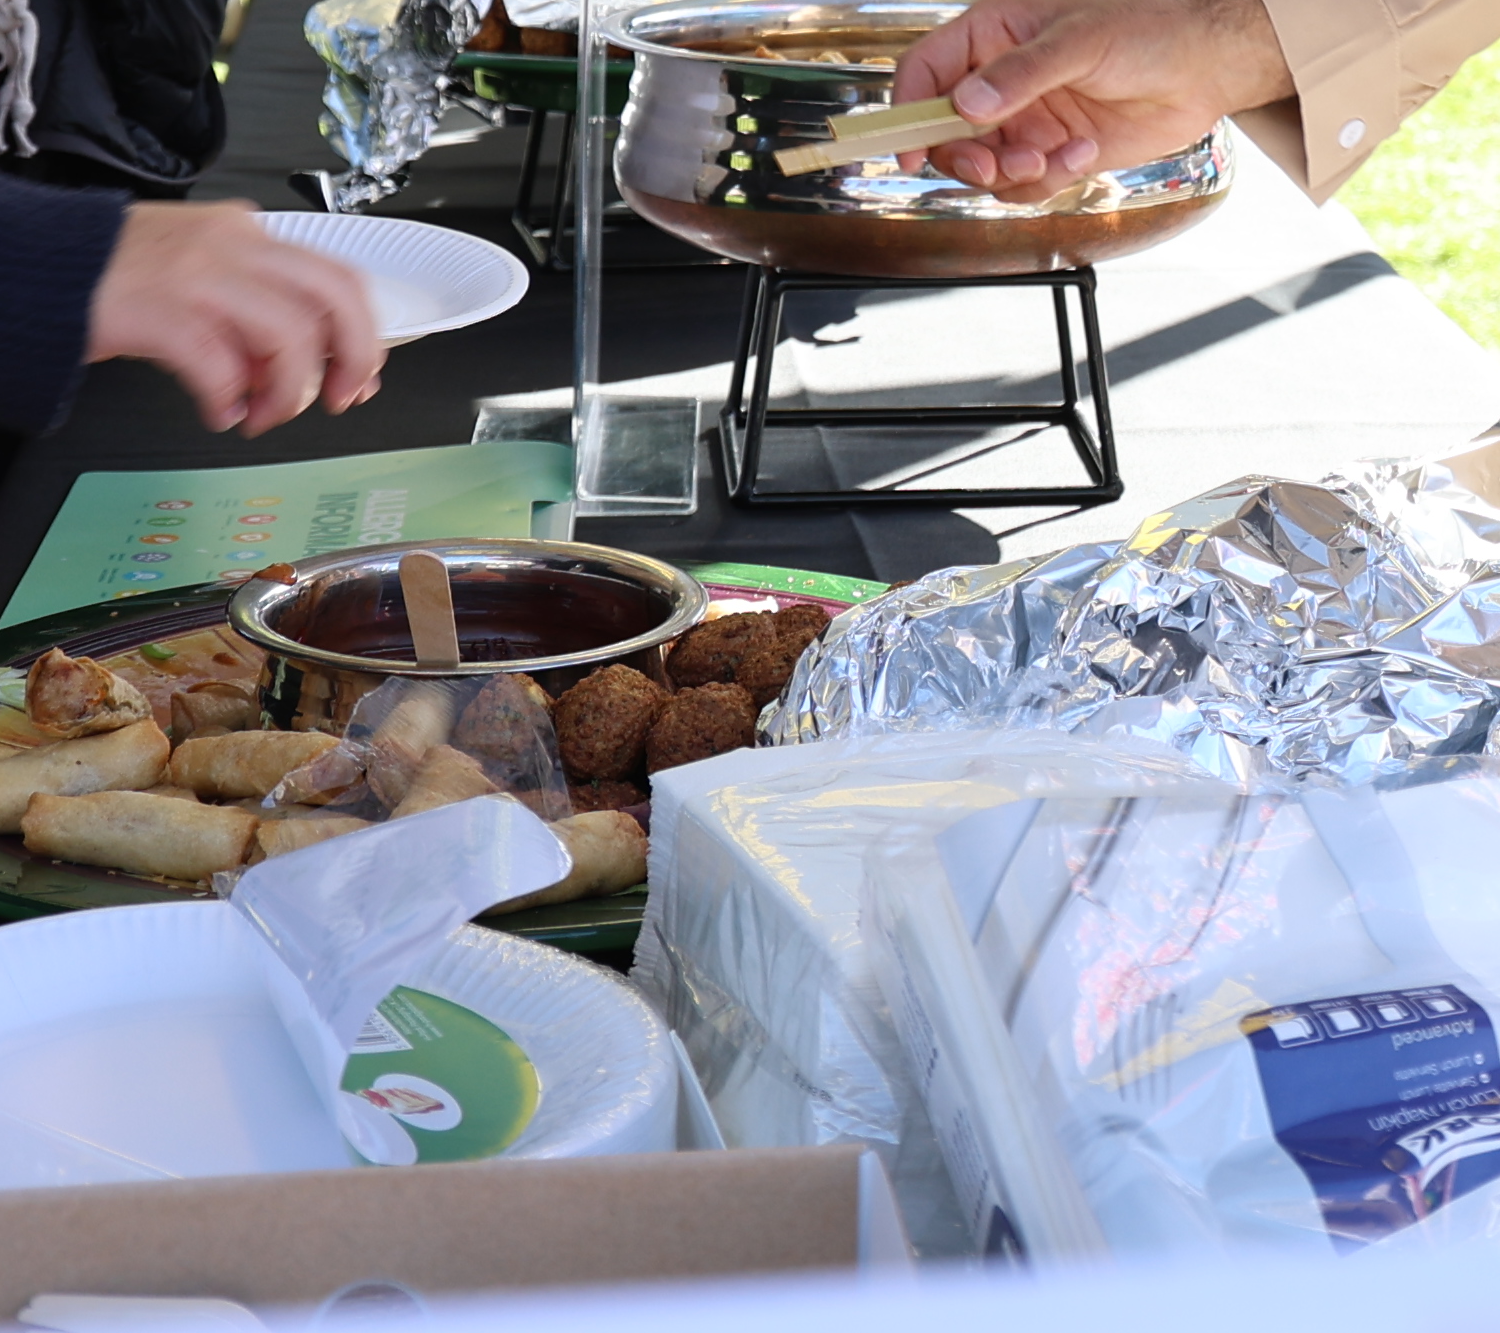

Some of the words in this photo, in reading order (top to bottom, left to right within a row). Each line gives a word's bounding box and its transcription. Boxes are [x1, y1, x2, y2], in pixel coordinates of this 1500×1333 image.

[302, 491, 360, 557] INFORMA
[356, 488, 409, 546] ALLERG
[1390, 1017, 1476, 1052] Advanced
[1367, 1105, 1441, 1132] Napkin
